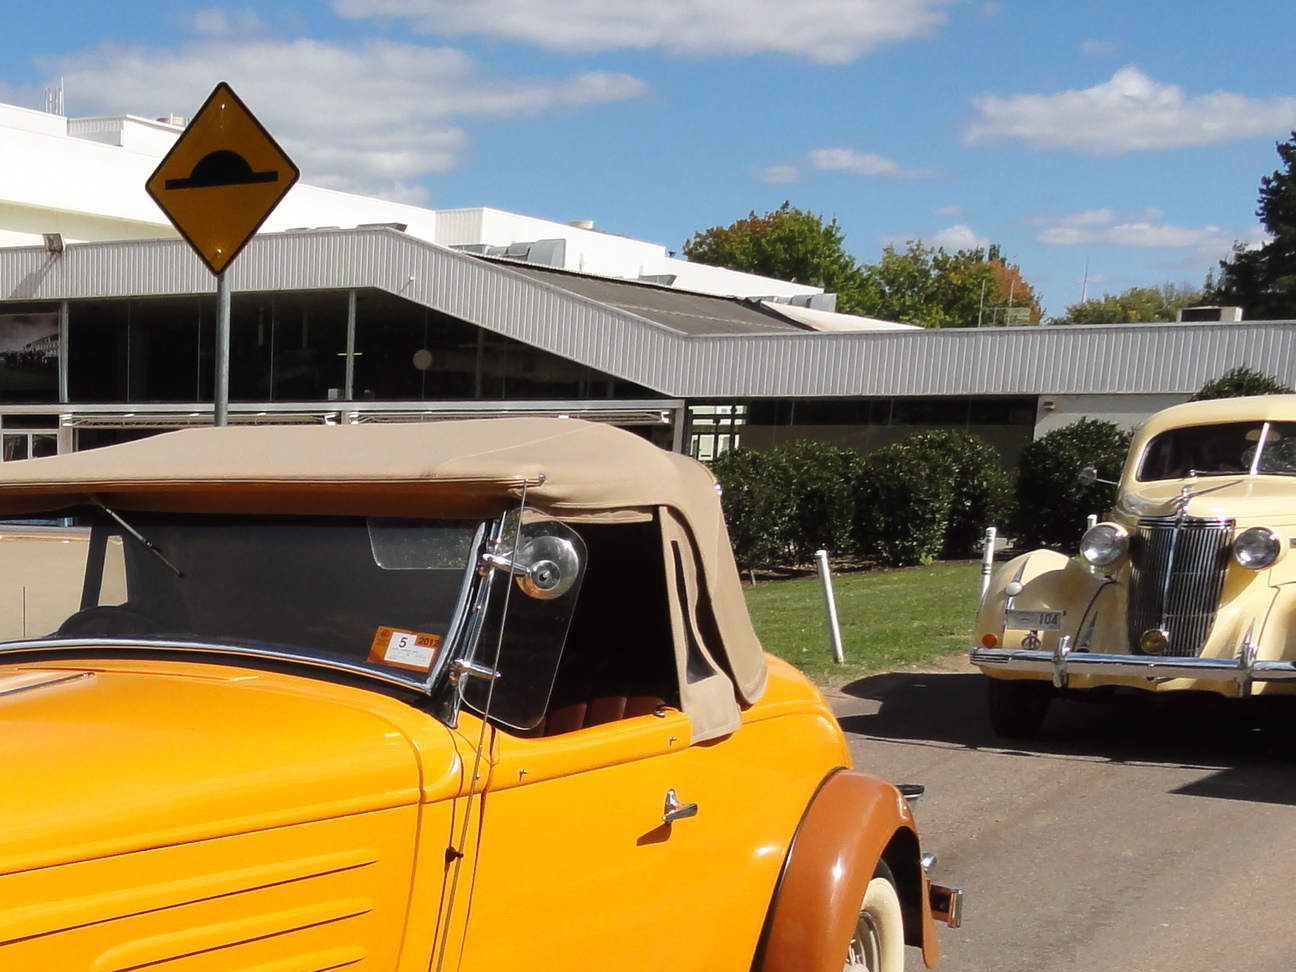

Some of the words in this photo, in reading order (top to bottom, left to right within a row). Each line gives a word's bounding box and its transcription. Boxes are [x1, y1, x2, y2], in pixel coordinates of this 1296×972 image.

[1039, 613, 1058, 625] 104
[398, 636, 408, 648] 5
[418, 636, 440, 647] 2012
